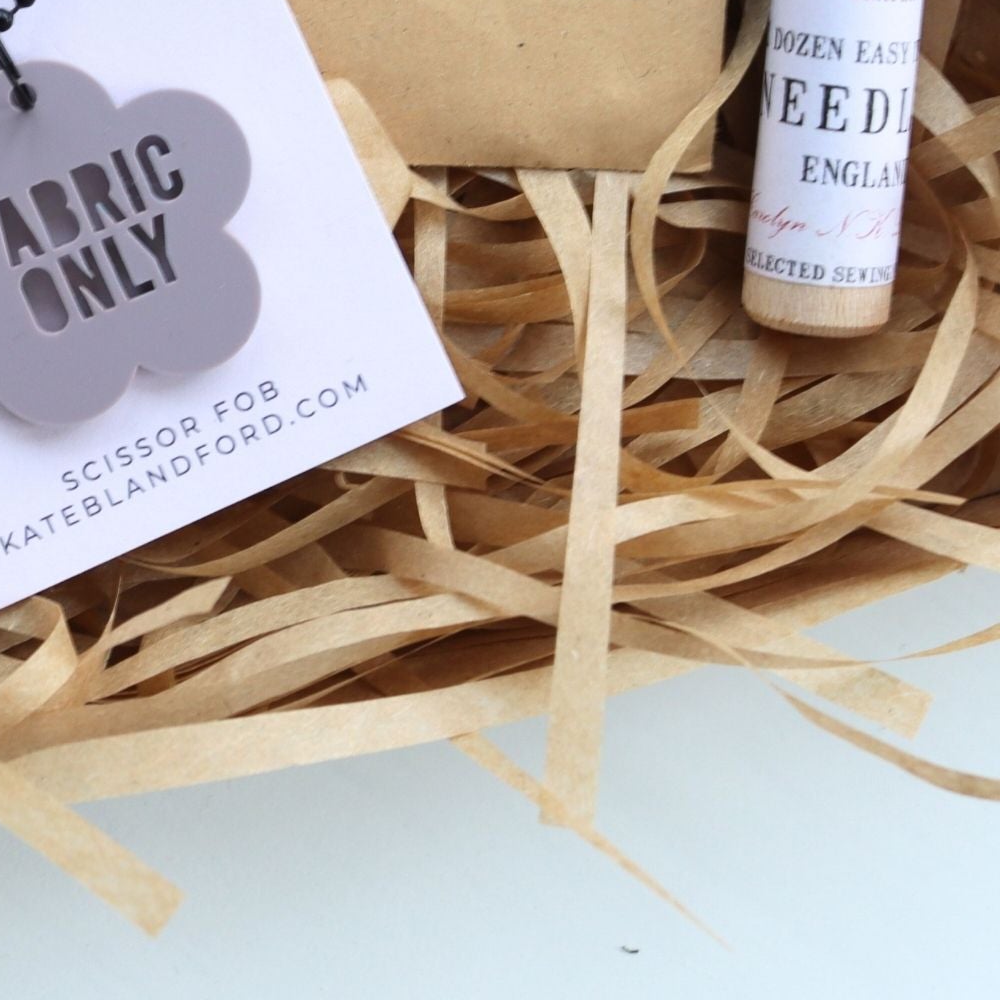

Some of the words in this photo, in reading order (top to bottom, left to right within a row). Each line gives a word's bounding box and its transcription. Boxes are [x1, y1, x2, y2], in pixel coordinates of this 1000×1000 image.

[773, 26, 845, 61] DOZEN
[19, 212, 178, 334] ONLY
[745, 247, 826, 281] SELECTED
[61, 415, 202, 492] SCISSOR
[212, 379, 281, 423] FOB
